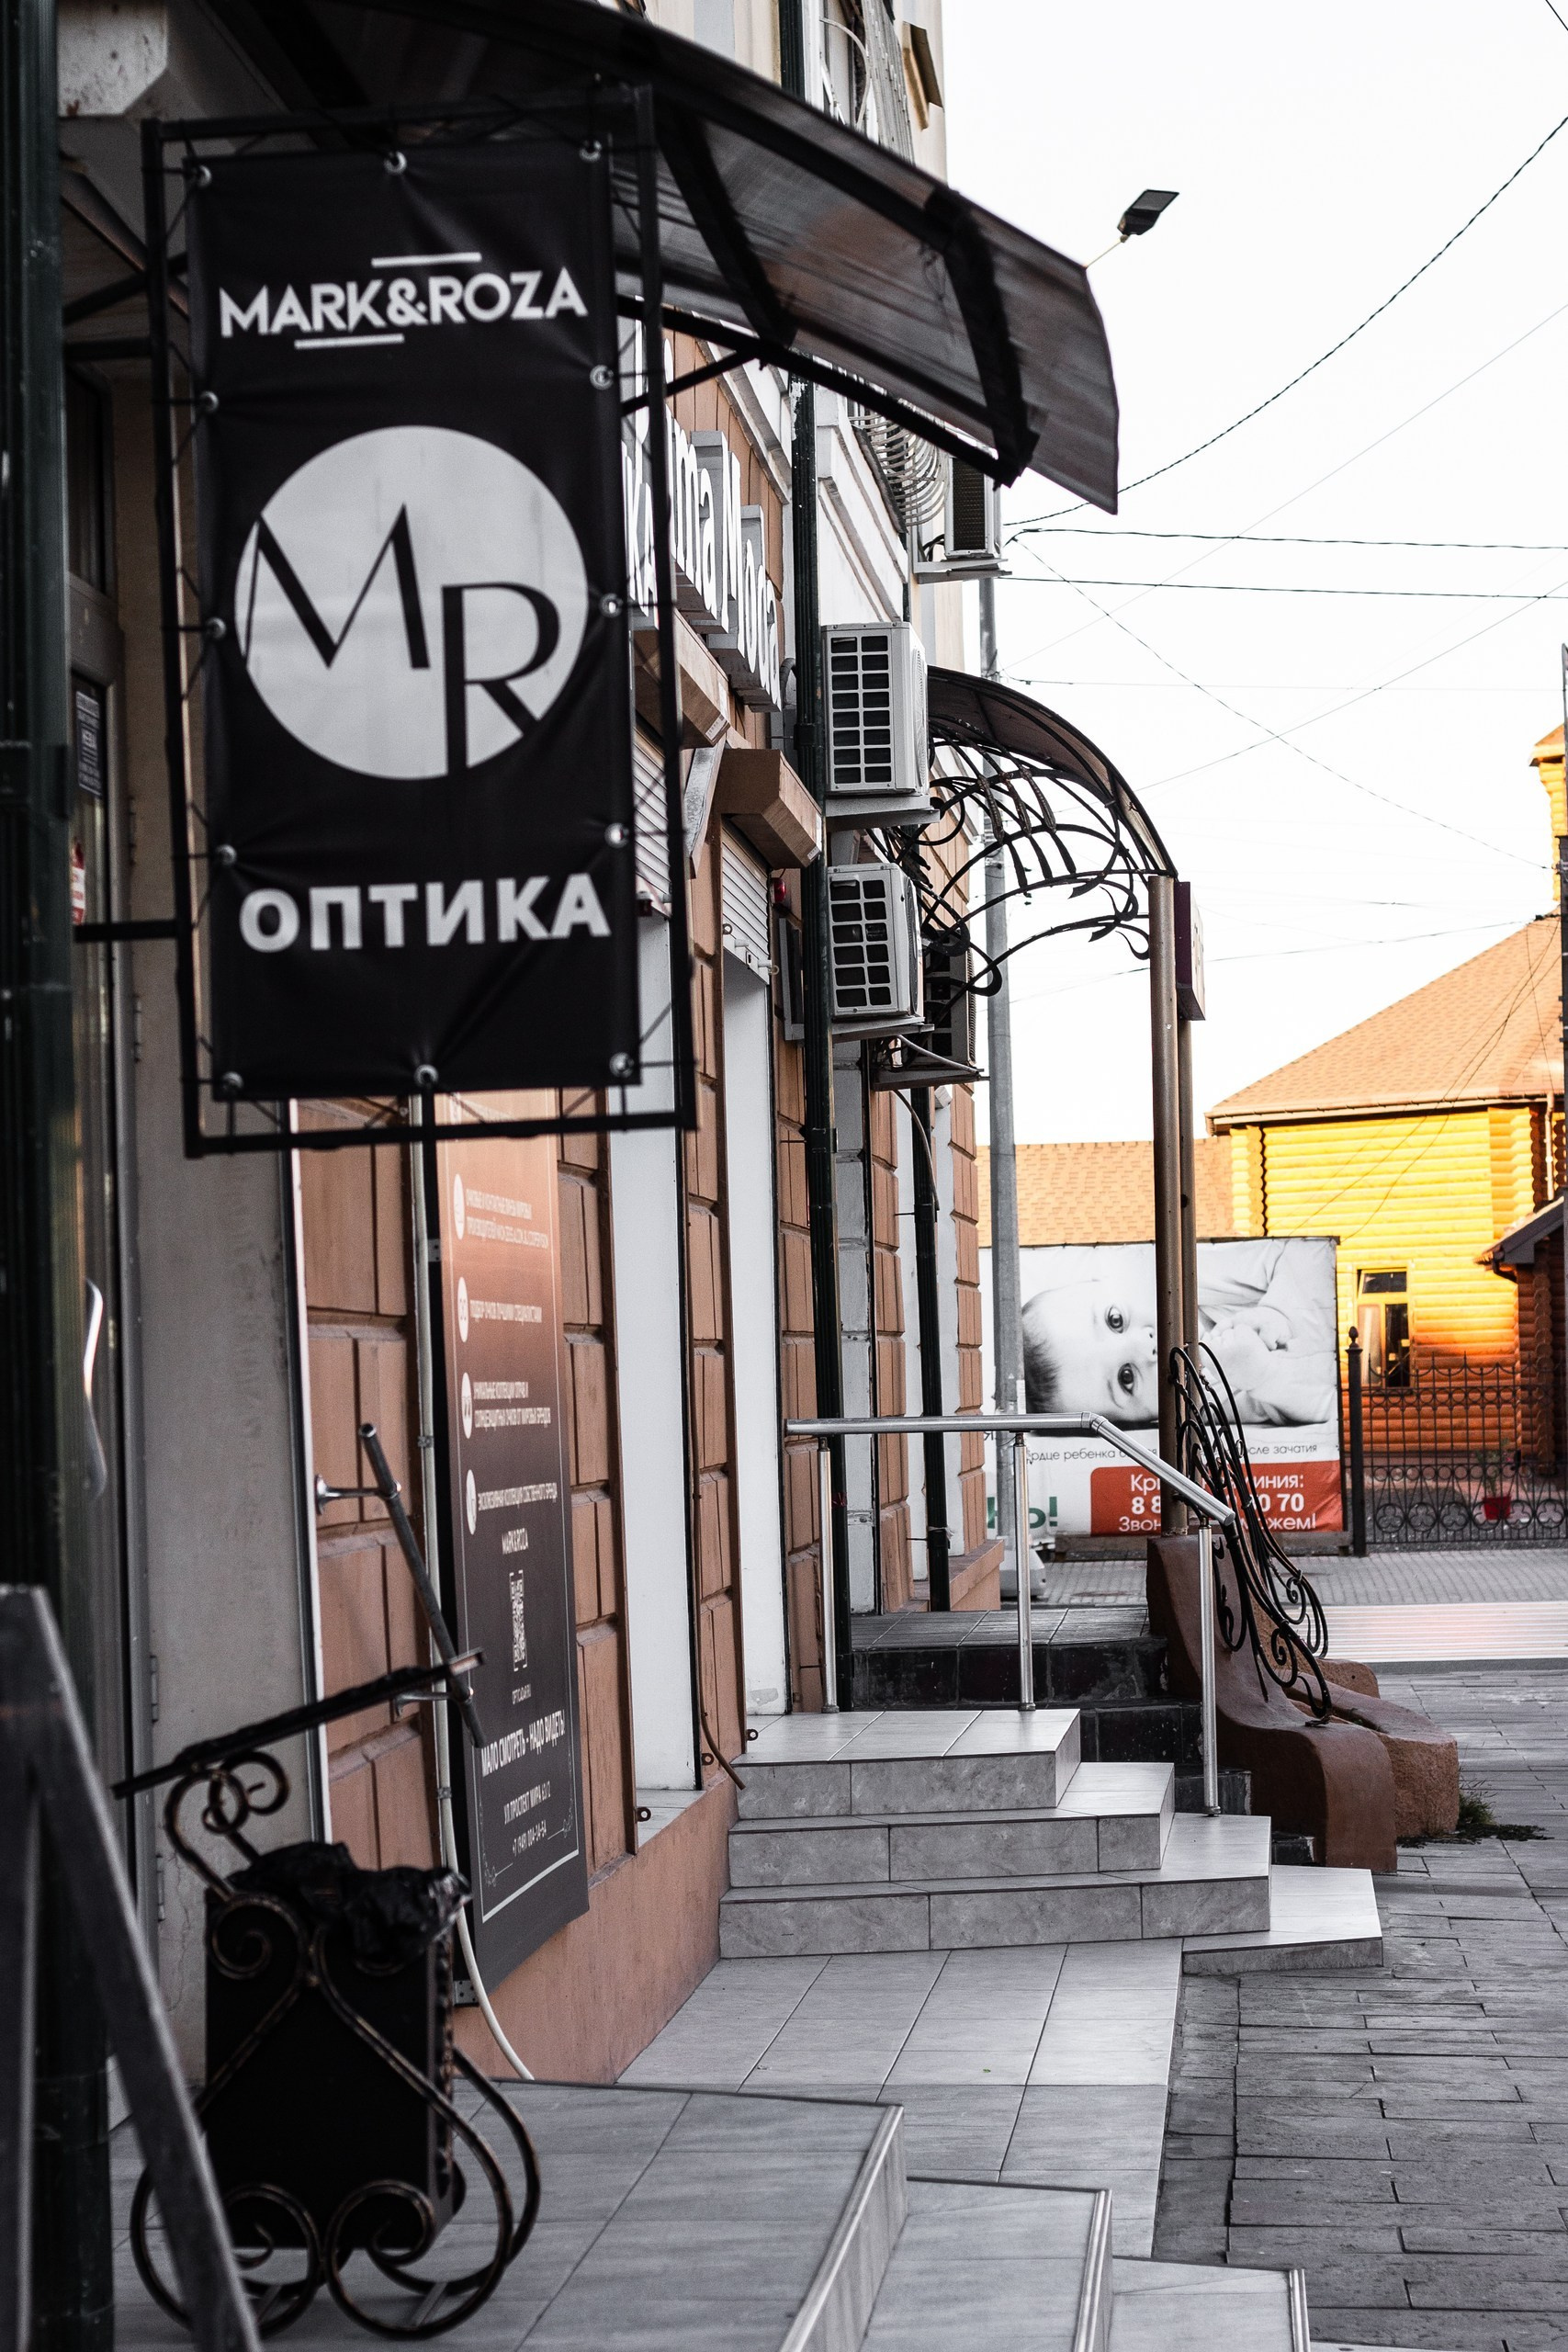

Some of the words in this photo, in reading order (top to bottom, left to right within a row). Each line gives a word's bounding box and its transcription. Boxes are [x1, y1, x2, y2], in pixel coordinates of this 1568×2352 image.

[219, 266, 588, 338] MARK&ROZA
[719, 430, 782, 712] Moda
[239, 872, 613, 953] ОПТИКА
[1064, 1447, 1116, 1462] ребенка
[1273, 1443, 1317, 1455] зачатия
[1131, 1496, 1145, 1515] 8
[1277, 1493, 1304, 1512] 70
[481, 1741, 499, 1778] МАЛО
[499, 1727, 526, 1768] СМОТРЕТЬ
[529, 1717, 545, 1756] НАДО
